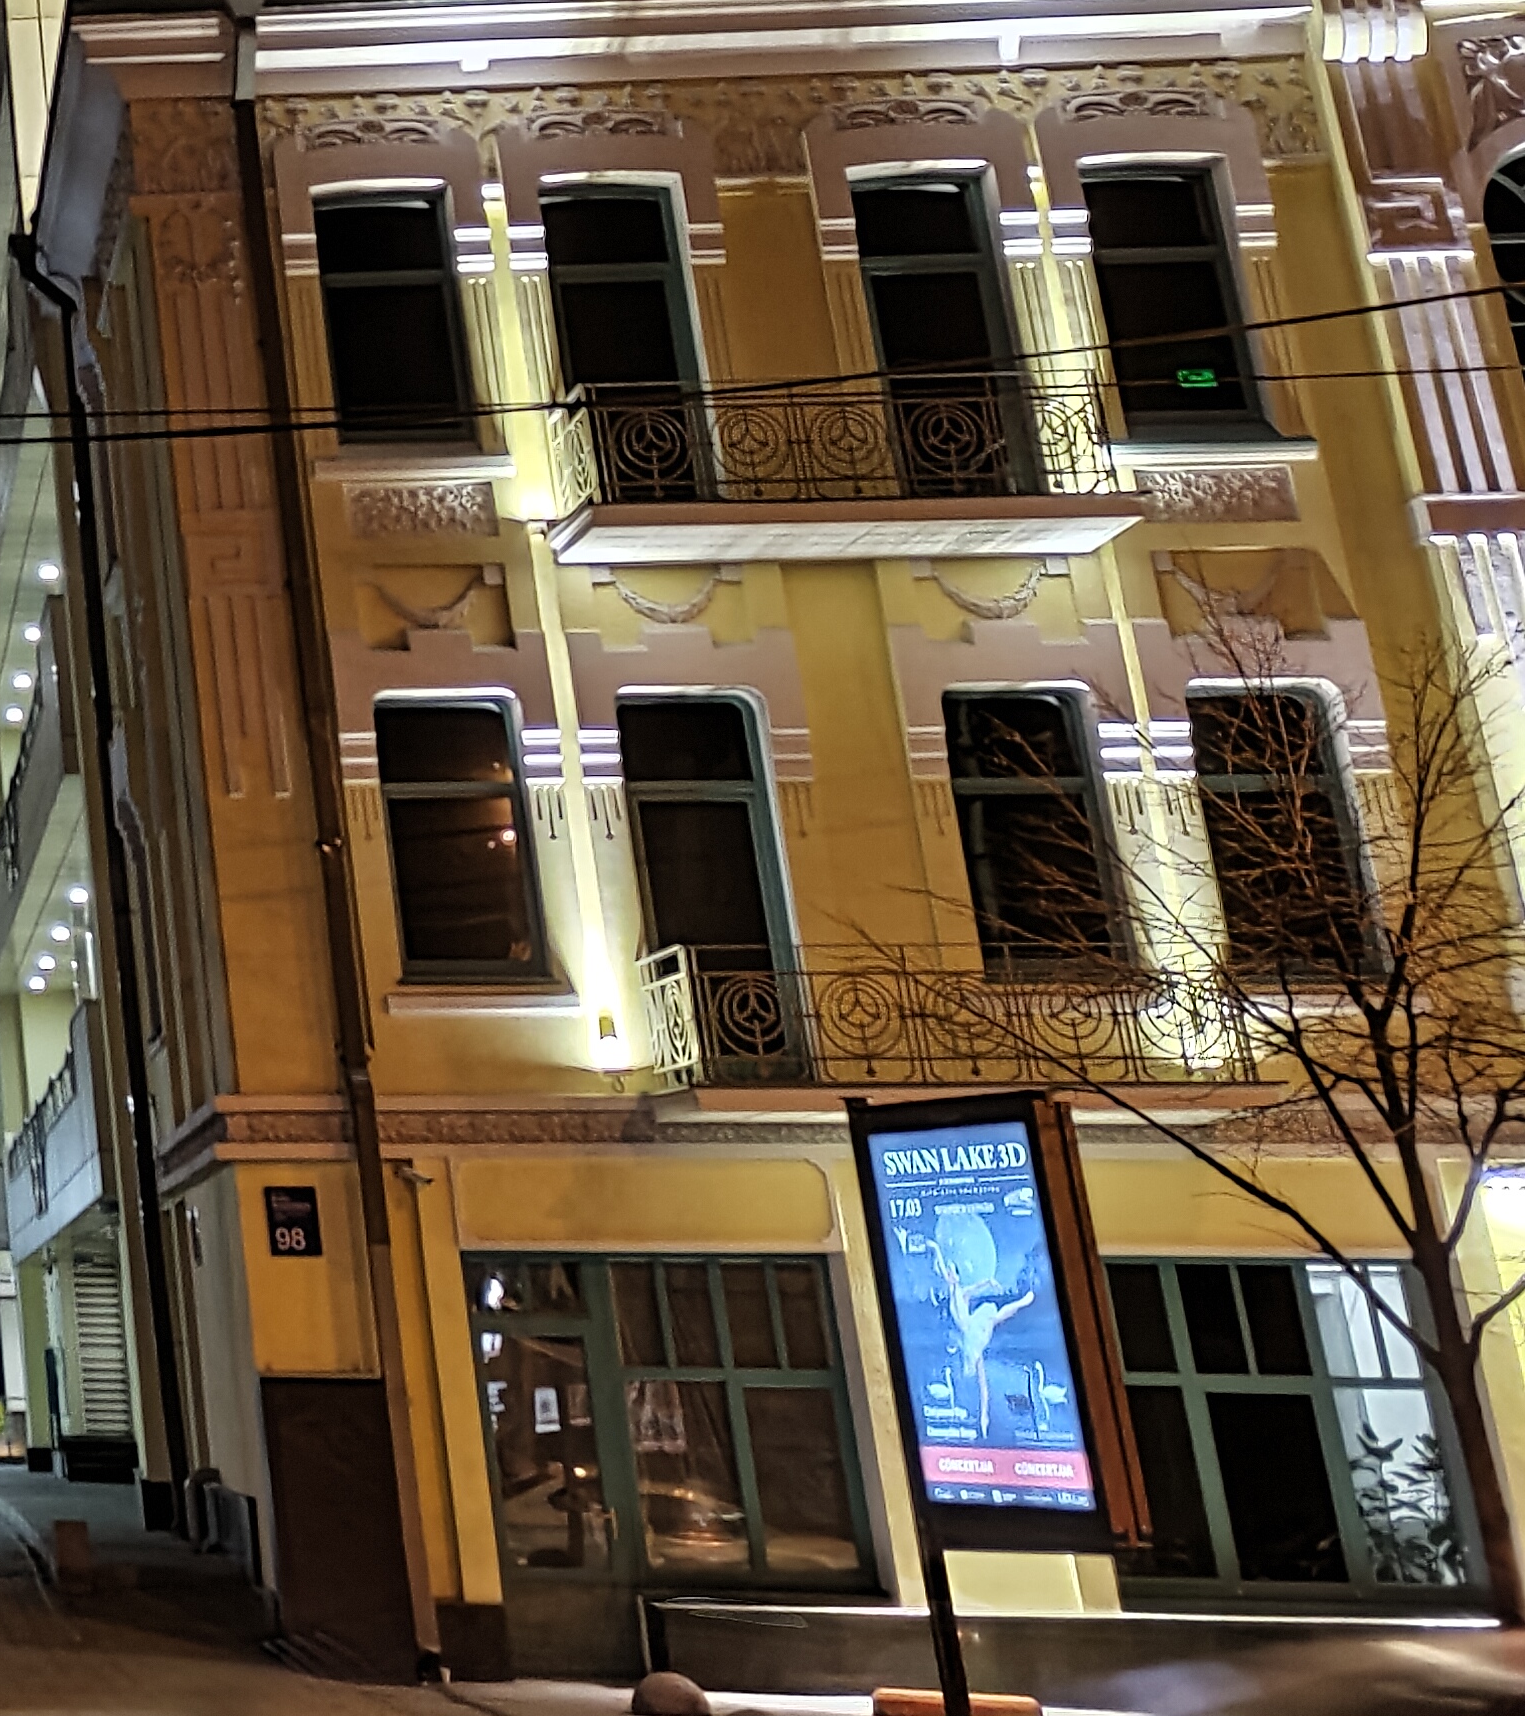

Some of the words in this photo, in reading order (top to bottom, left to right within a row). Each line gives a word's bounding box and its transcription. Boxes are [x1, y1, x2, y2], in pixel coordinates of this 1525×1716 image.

[883, 1149, 940, 1176] SWAN
[941, 1144, 997, 1172] LAKE
[997, 1142, 1027, 1168] 3D
[275, 1227, 306, 1251] 98
